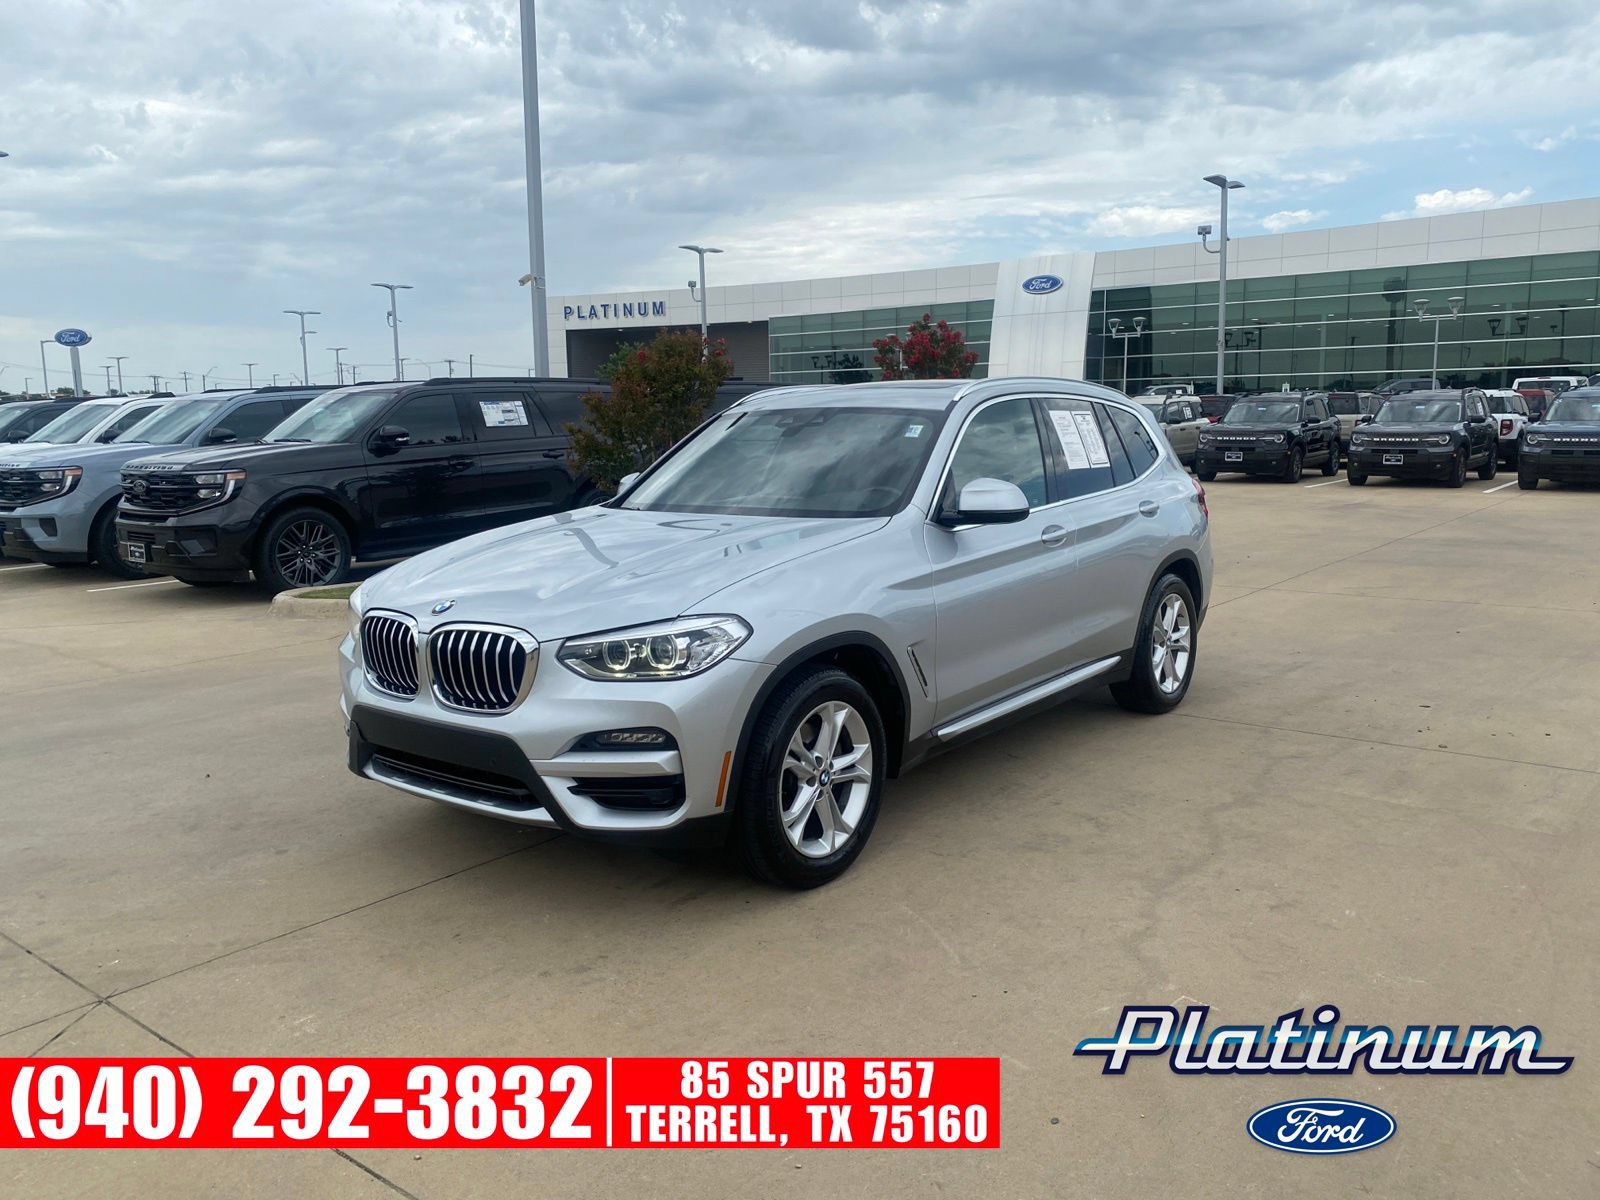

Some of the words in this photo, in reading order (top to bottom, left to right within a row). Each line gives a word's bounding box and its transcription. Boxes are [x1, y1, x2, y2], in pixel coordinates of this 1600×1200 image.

[1029, 278, 1053, 290] Ford
[563, 301, 666, 321] PLATINUM
[60, 331, 81, 343] Ford
